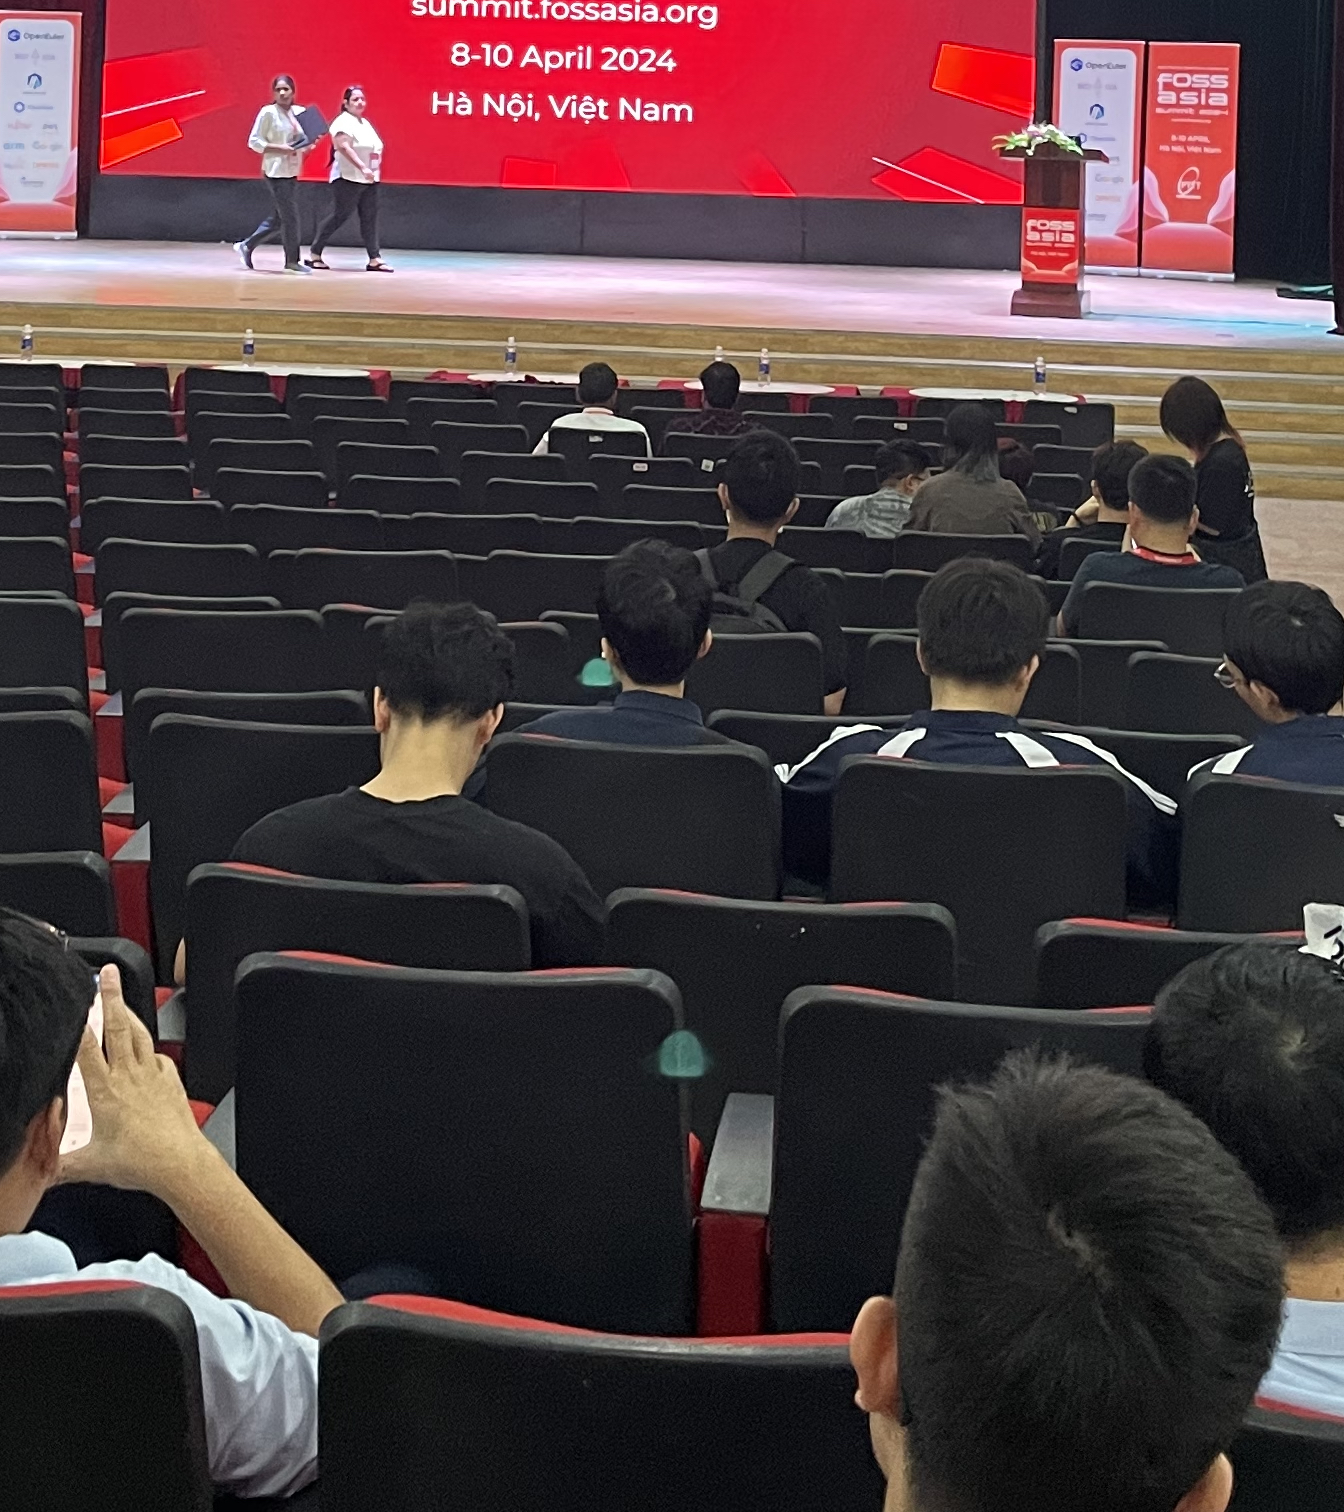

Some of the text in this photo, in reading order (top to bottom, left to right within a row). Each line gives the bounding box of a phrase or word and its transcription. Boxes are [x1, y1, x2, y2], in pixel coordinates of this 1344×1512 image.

[449, 43, 678, 74] 8-10 April 2024
[431, 91, 694, 125] Hà Nội, Việt Nam
